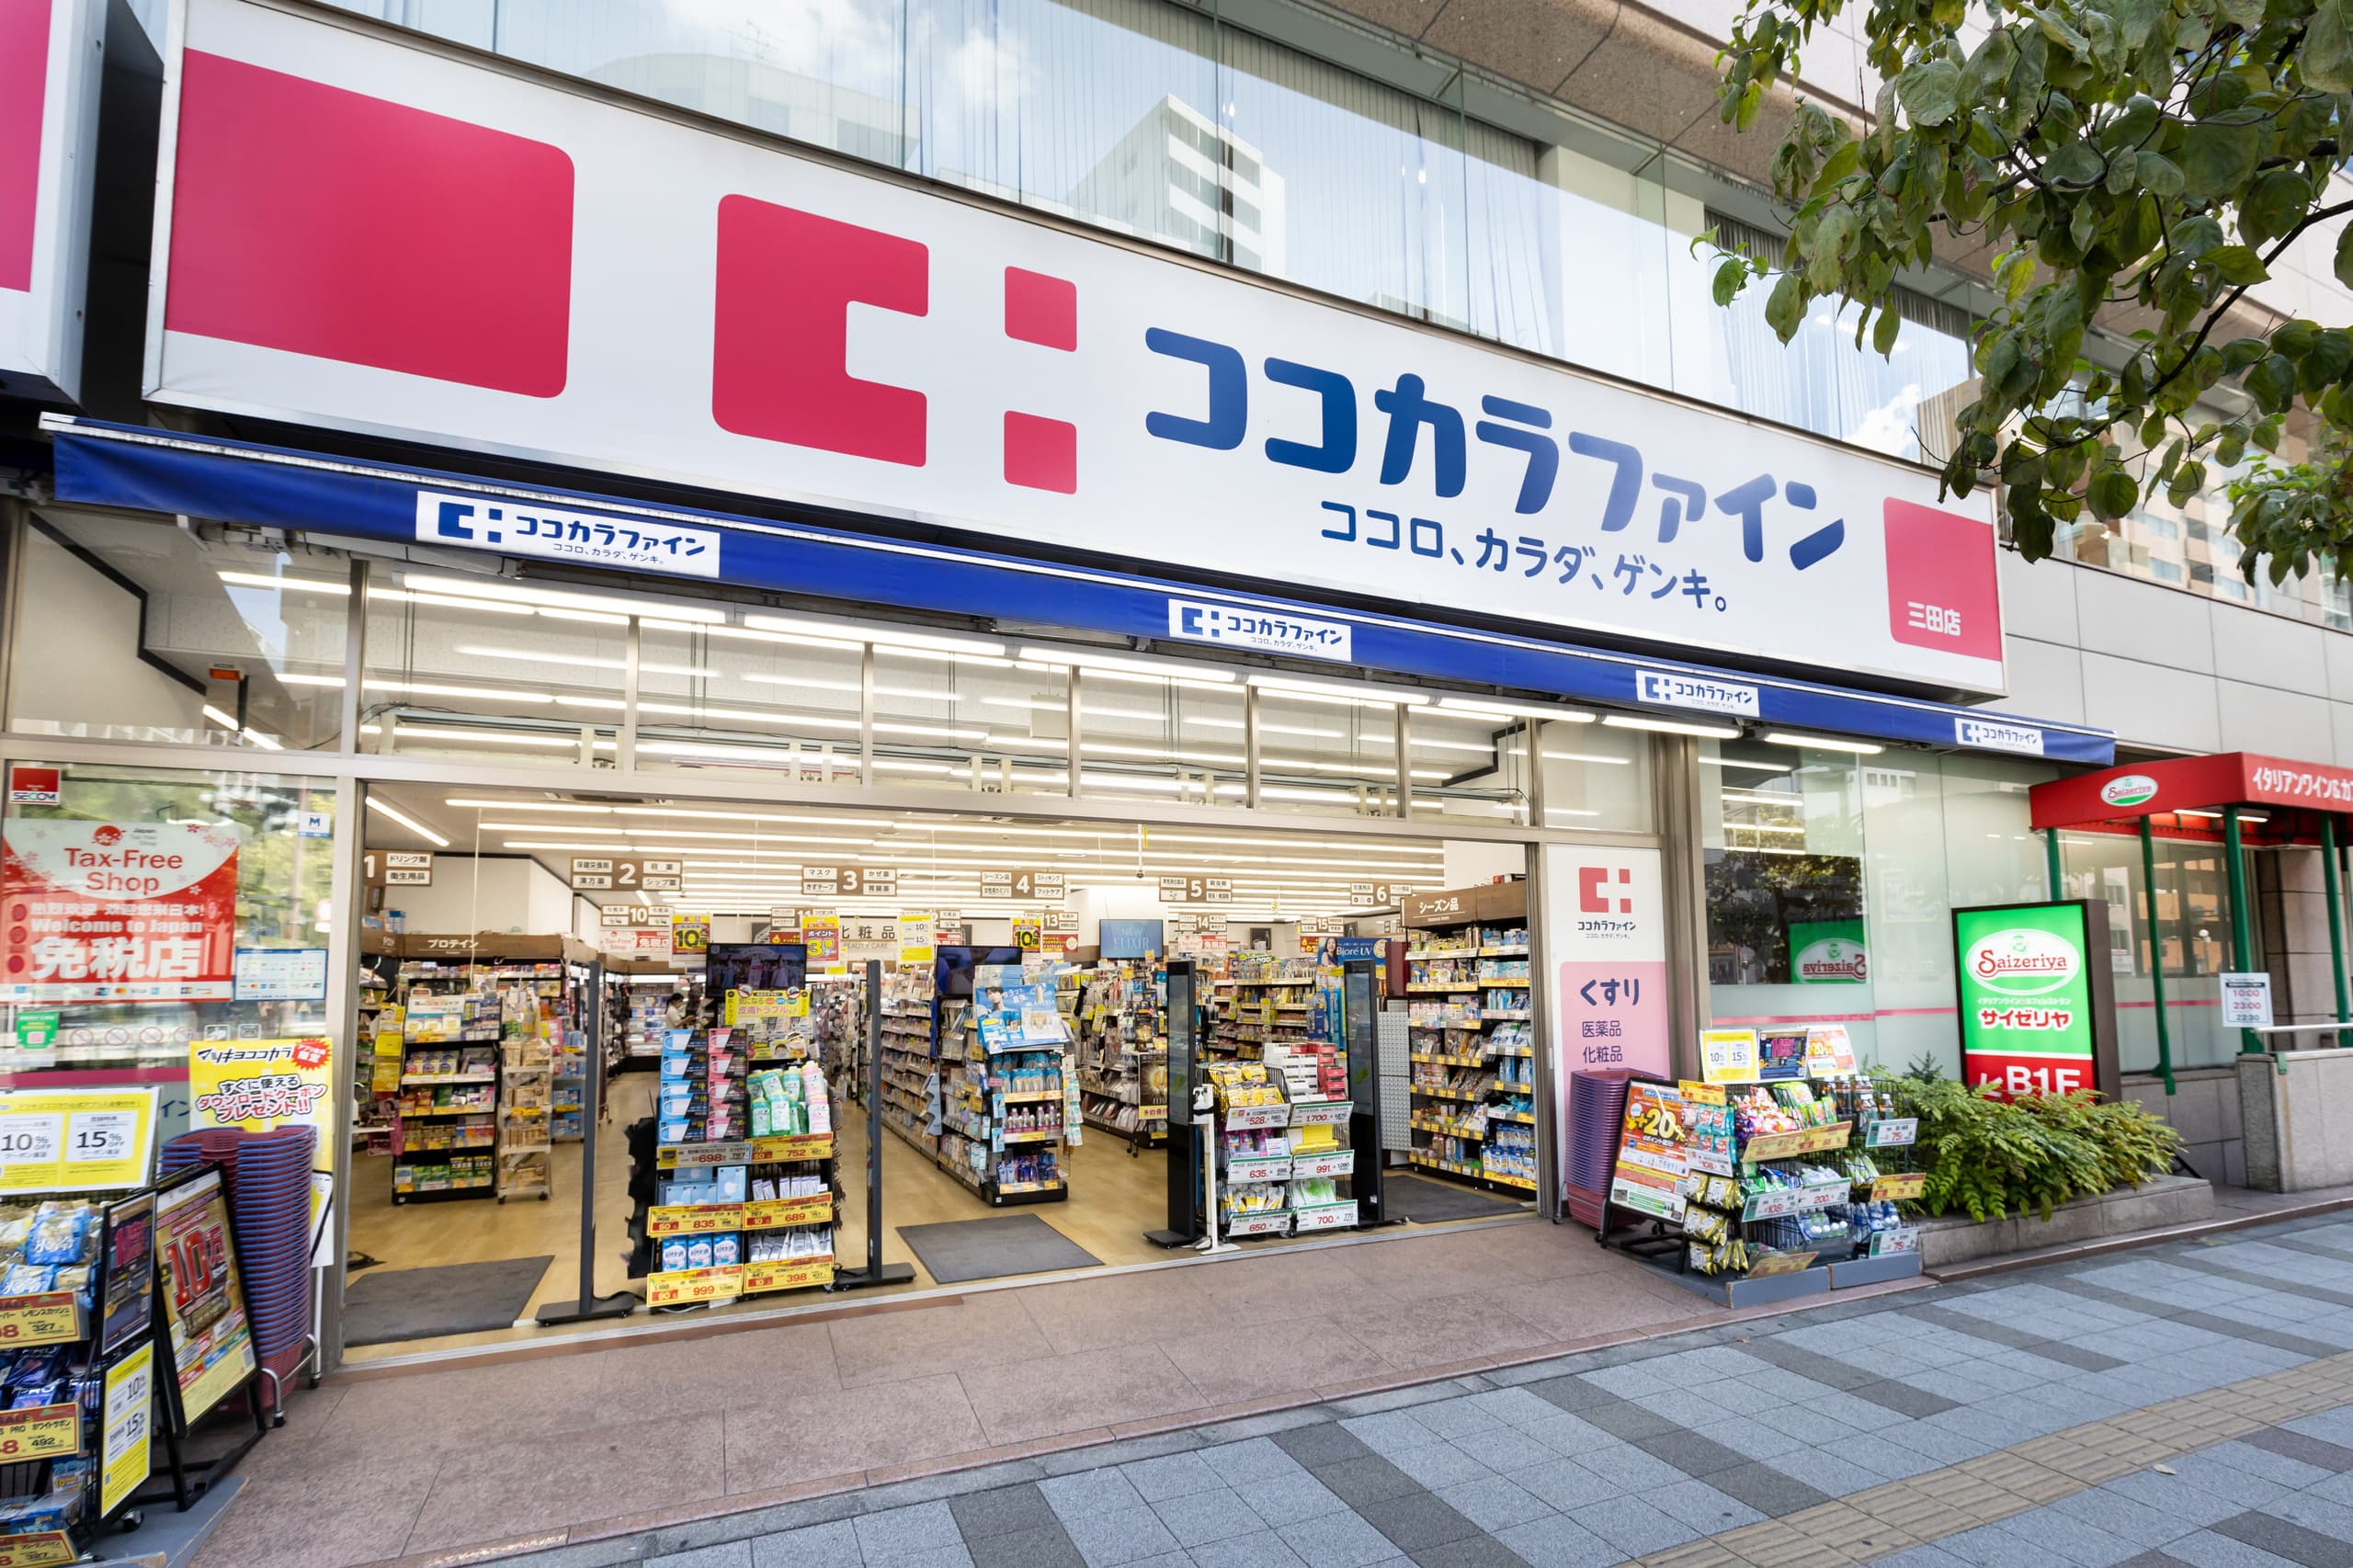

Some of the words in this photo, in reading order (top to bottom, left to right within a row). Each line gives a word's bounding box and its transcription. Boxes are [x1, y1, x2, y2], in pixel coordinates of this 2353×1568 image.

[1145, 326, 1844, 571] ココカラファイン
[515, 515, 706, 557] ココカラファイン
[552, 542, 665, 565] ココロ、カラダ、ゲンキ。
[1320, 501, 1728, 613] ココロ、カラダ、ゲンキ。
[1906, 600, 1962, 637] 三田店
[1227, 615, 1343, 646] ココカラファイン
[1251, 635, 1318, 653] ココロ、カラダ、ゲンキ。
[1675, 681, 1753, 705] ココカラファイン
[1982, 726, 2039, 744] ココカラファイン
[2252, 767, 2353, 802] イタリアンワイン&カ
[13, 790, 57, 801] SECOM
[63, 846, 184, 869] Tax-Free
[363, 854, 375, 879] 1
[619, 862, 636, 884] 2
[85, 871, 160, 895] Shop
[843, 869, 858, 891] 3
[1016, 875, 1030, 894] 4
[1190, 880, 1203, 898] 5
[1376, 885, 1387, 903] 6
[1418, 897, 1460, 915] シーズン品
[630, 908, 648, 923] 10
[1044, 914, 1059, 927] 13
[1197, 916, 1210, 929] 14
[31, 919, 123, 933] Welcome
[127, 920, 146, 933] to
[149, 919, 203, 934] Japan
[841, 924, 895, 939] 化粧品
[1121, 926, 1143, 937] NEW
[1317, 918, 1328, 930] 15
[1577, 920, 1637, 931] ココカラファイン
[427, 938, 479, 949] プロテイン
[1113, 937, 1150, 949] ELIXIR
[29, 936, 201, 980] 免税店
[1360, 947, 1373, 956] UV
[1975, 949, 2068, 978] Saizeriya
[1580, 978, 1640, 1006] くすり
[2233, 989, 2260, 997] 10:00
[2233, 1002, 2262, 1010] 23:00
[1980, 1008, 2070, 1028] サイゼリヤ
[1582, 1020, 1622, 1038] 医薬品
[198, 1046, 293, 1063] マツキヨココカラ
[1582, 1045, 1623, 1063] 化粧品
[1710, 1051, 1720, 1062] 10
[1732, 1051, 1743, 1062] 15
[222, 1075, 301, 1094] すぐに使える
[2006, 1065, 2081, 1100] B1F
[198, 1085, 325, 1110] ダウンロードクーポン
[218, 1098, 310, 1121] プレゼント!!
[1249, 1116, 1265, 1126] 528
[1, 1133, 33, 1152] 10
[76, 1131, 108, 1149] 15
[108, 1133, 122, 1142] %
[1892, 1131, 1902, 1141] 75
[699, 1153, 722, 1164] 698
[786, 1149, 807, 1157] 752
[1249, 1169, 1267, 1178] 635
[1315, 1165, 1331, 1174] 991
[1813, 1194, 1829, 1204] 200
[693, 1219, 716, 1229] 835
[785, 1212, 806, 1222] 689
[1316, 1214, 1335, 1225] 700
[1248, 1222, 1267, 1232] 650
[1893, 1242, 1904, 1251] 75
[786, 1272, 808, 1283] 398
[693, 1285, 715, 1296] 999
[32, 1323, 55, 1332] 327
[10, 1426, 26, 1435] PRO
[31, 1437, 55, 1447] 492
